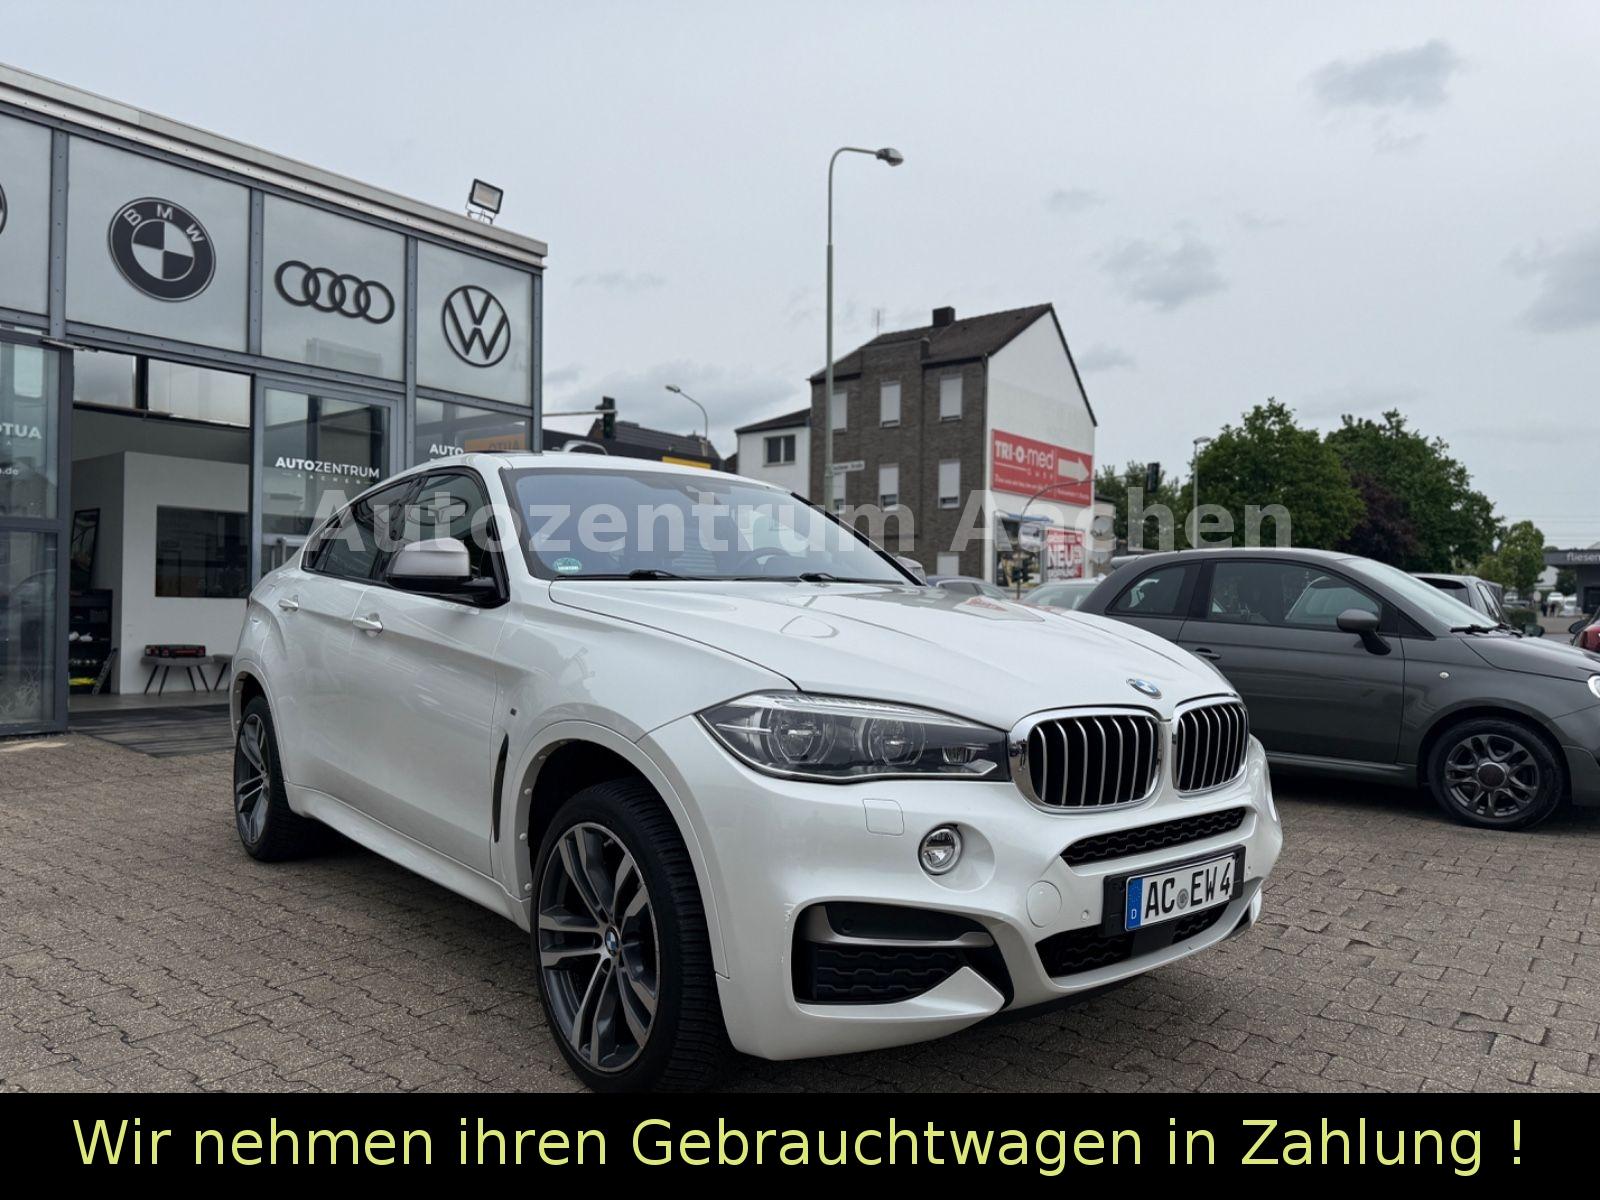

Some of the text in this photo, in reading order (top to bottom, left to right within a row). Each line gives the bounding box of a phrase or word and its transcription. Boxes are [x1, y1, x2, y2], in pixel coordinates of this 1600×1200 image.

[123, 204, 203, 243] BMW
[275, 457, 380, 478] AUTOZENTRUM
[1144, 877, 1176, 919] AC
[1131, 909, 1137, 920] D
